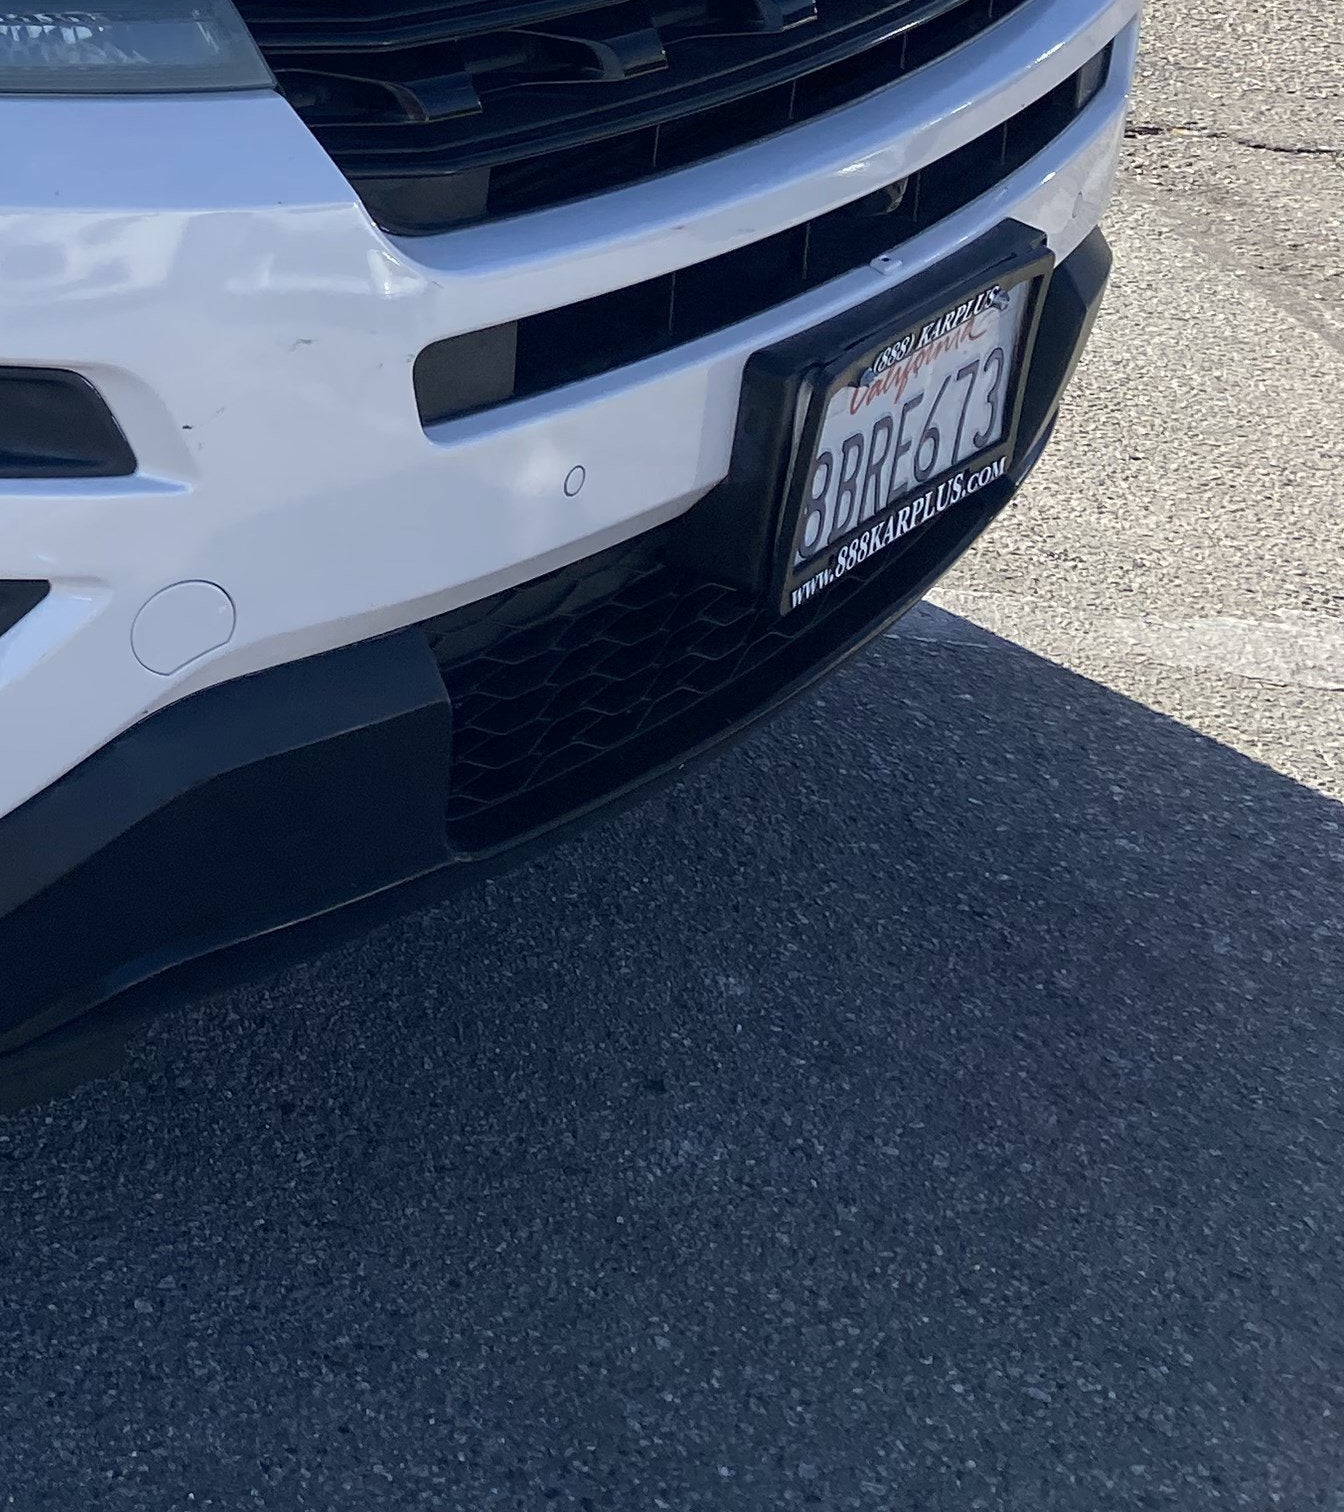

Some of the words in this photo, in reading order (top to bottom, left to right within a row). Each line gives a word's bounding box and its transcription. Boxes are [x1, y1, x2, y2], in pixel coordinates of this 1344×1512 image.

[873, 333, 915, 373] (888)
[917, 286, 1002, 350] KARPLUS
[798, 347, 1003, 558] 8BRE673
